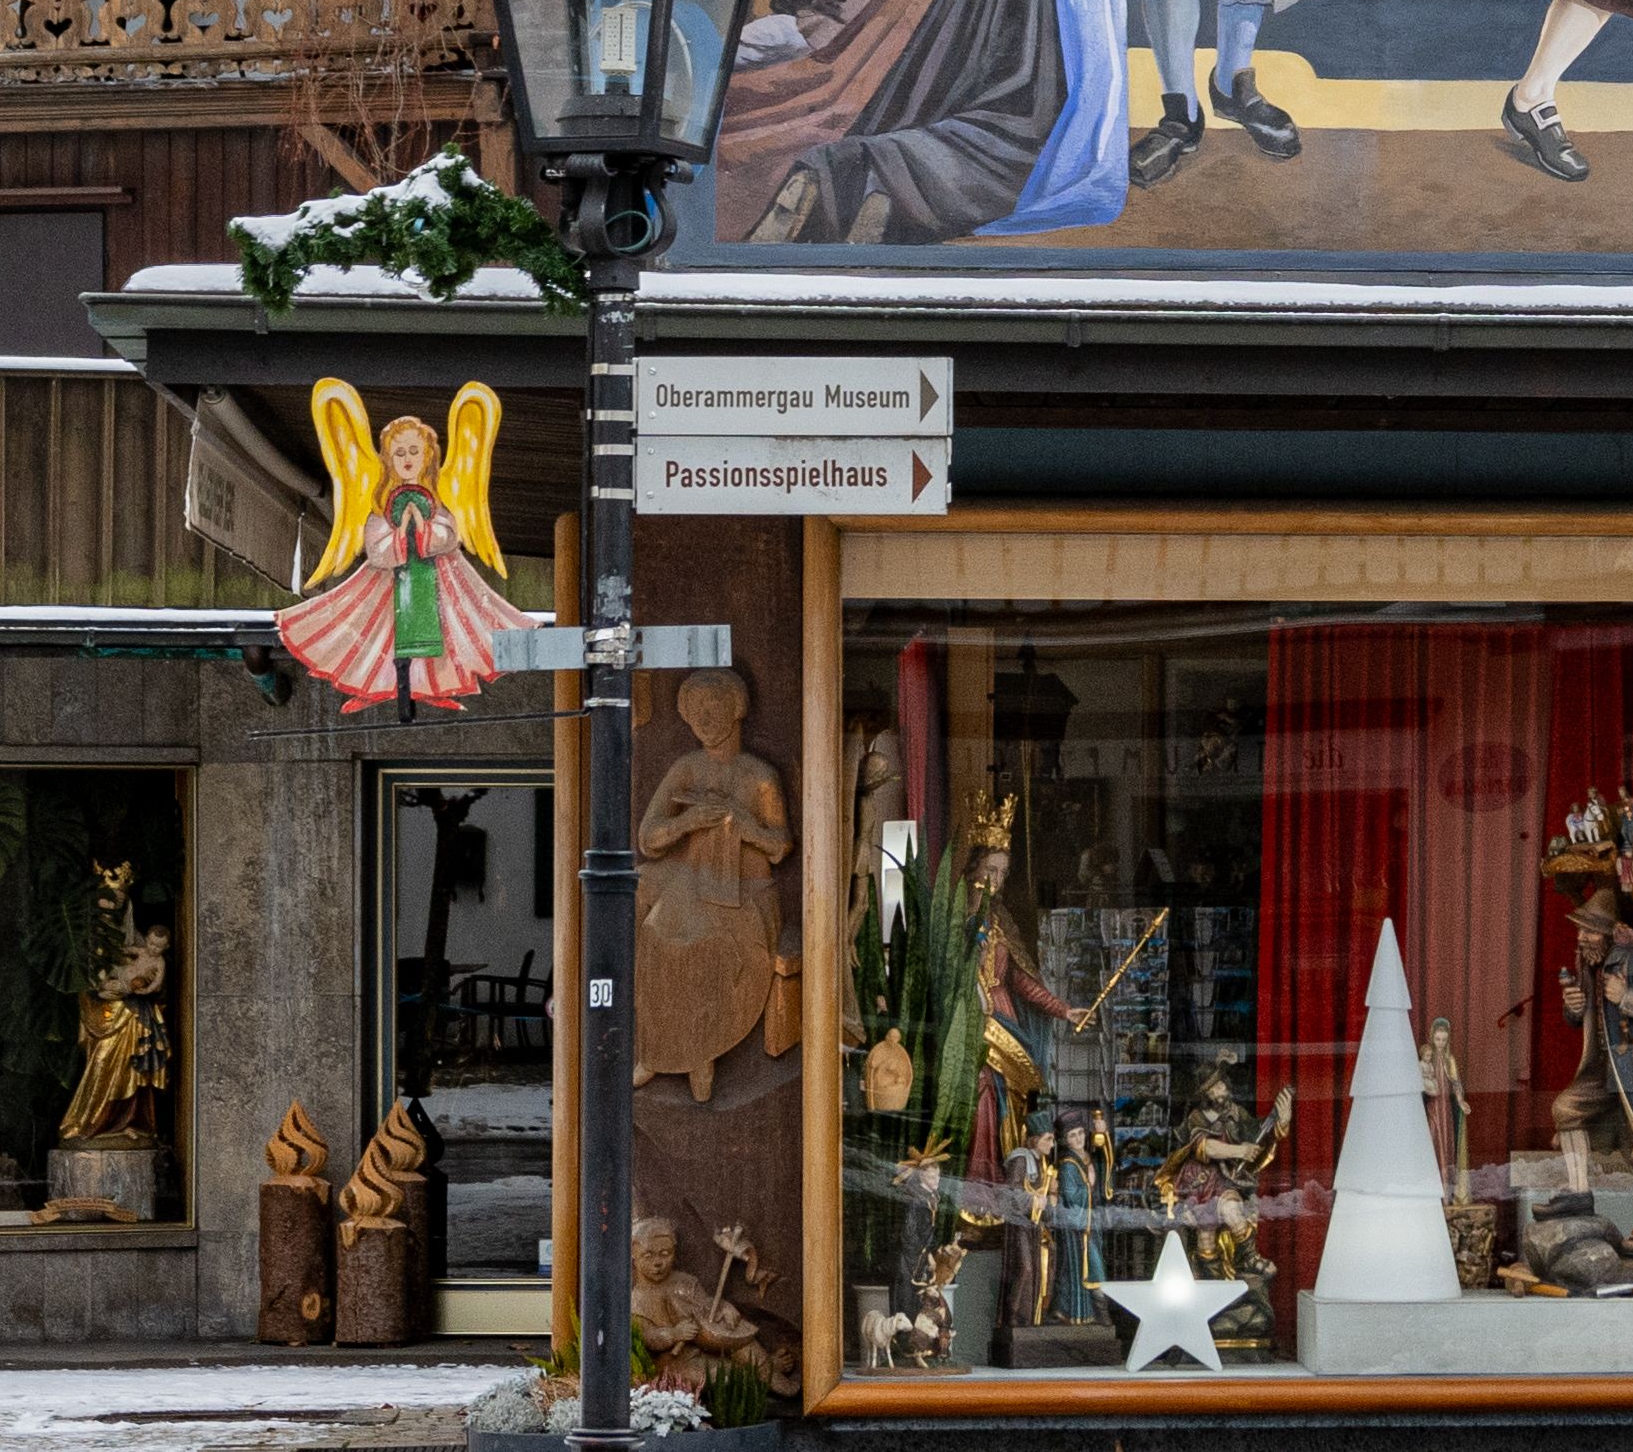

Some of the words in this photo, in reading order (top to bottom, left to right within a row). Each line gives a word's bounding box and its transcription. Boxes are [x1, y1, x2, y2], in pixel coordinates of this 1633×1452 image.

[655, 384, 814, 414] Oberammergau
[825, 385, 910, 409] Museum
[665, 459, 888, 493] Passionsspielhaus
[591, 983, 611, 1004] 30
